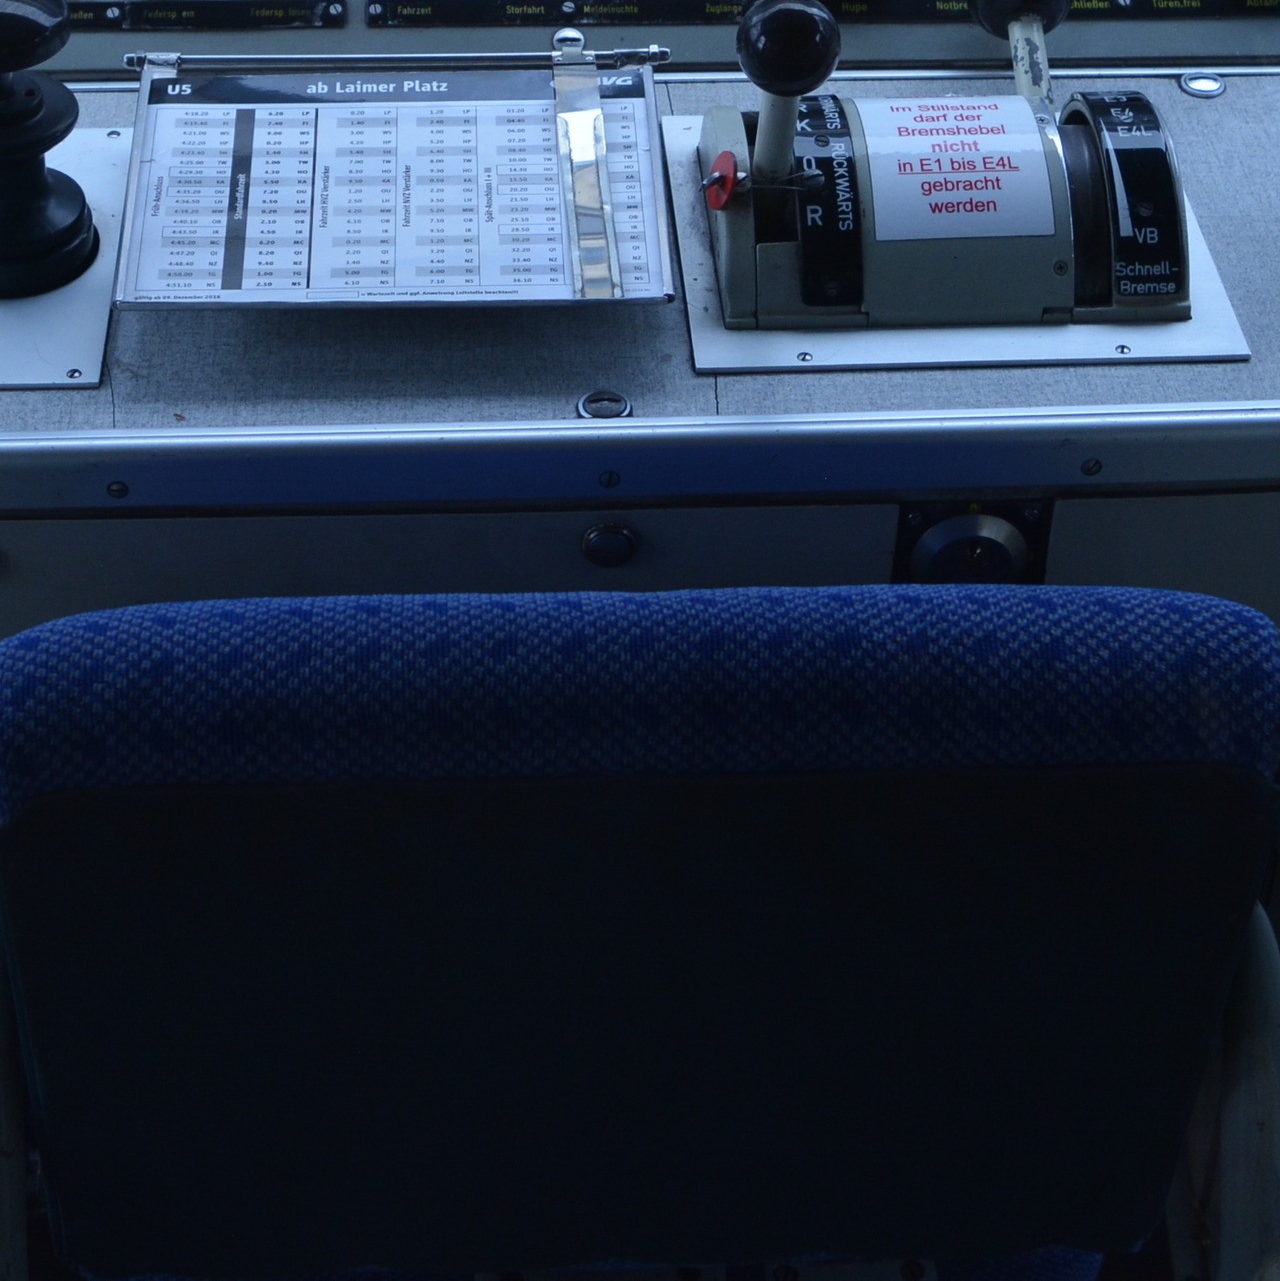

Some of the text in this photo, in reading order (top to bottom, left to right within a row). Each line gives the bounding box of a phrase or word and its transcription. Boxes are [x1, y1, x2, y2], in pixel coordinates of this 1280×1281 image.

[397, 4, 432, 16] Fahrzeit
[582, 3, 640, 15] Meldeleuchte
[840, 1, 869, 14] Hupe
[166, 83, 193, 95] U5
[306, 80, 449, 94] ab Laimer Platz
[889, 103, 999, 113] Im Stillstand
[913, 112, 984, 123] darf der
[896, 124, 1007, 137] Bremshebel
[1117, 125, 1153, 137] E4L
[930, 139, 981, 154] nicht
[897, 155, 1019, 173] in E1 bis E4L
[321, 165, 330, 193] Verstärker
[402, 165, 411, 192] Verstärker
[831, 142, 854, 231] RÜCKWÄRTS
[920, 176, 1003, 197] gebracht
[928, 198, 998, 214] werden
[806, 205, 824, 226] R
[1133, 227, 1160, 245] VB
[1116, 260, 1179, 276] Schnell-
[1120, 280, 1177, 295] Bremse
